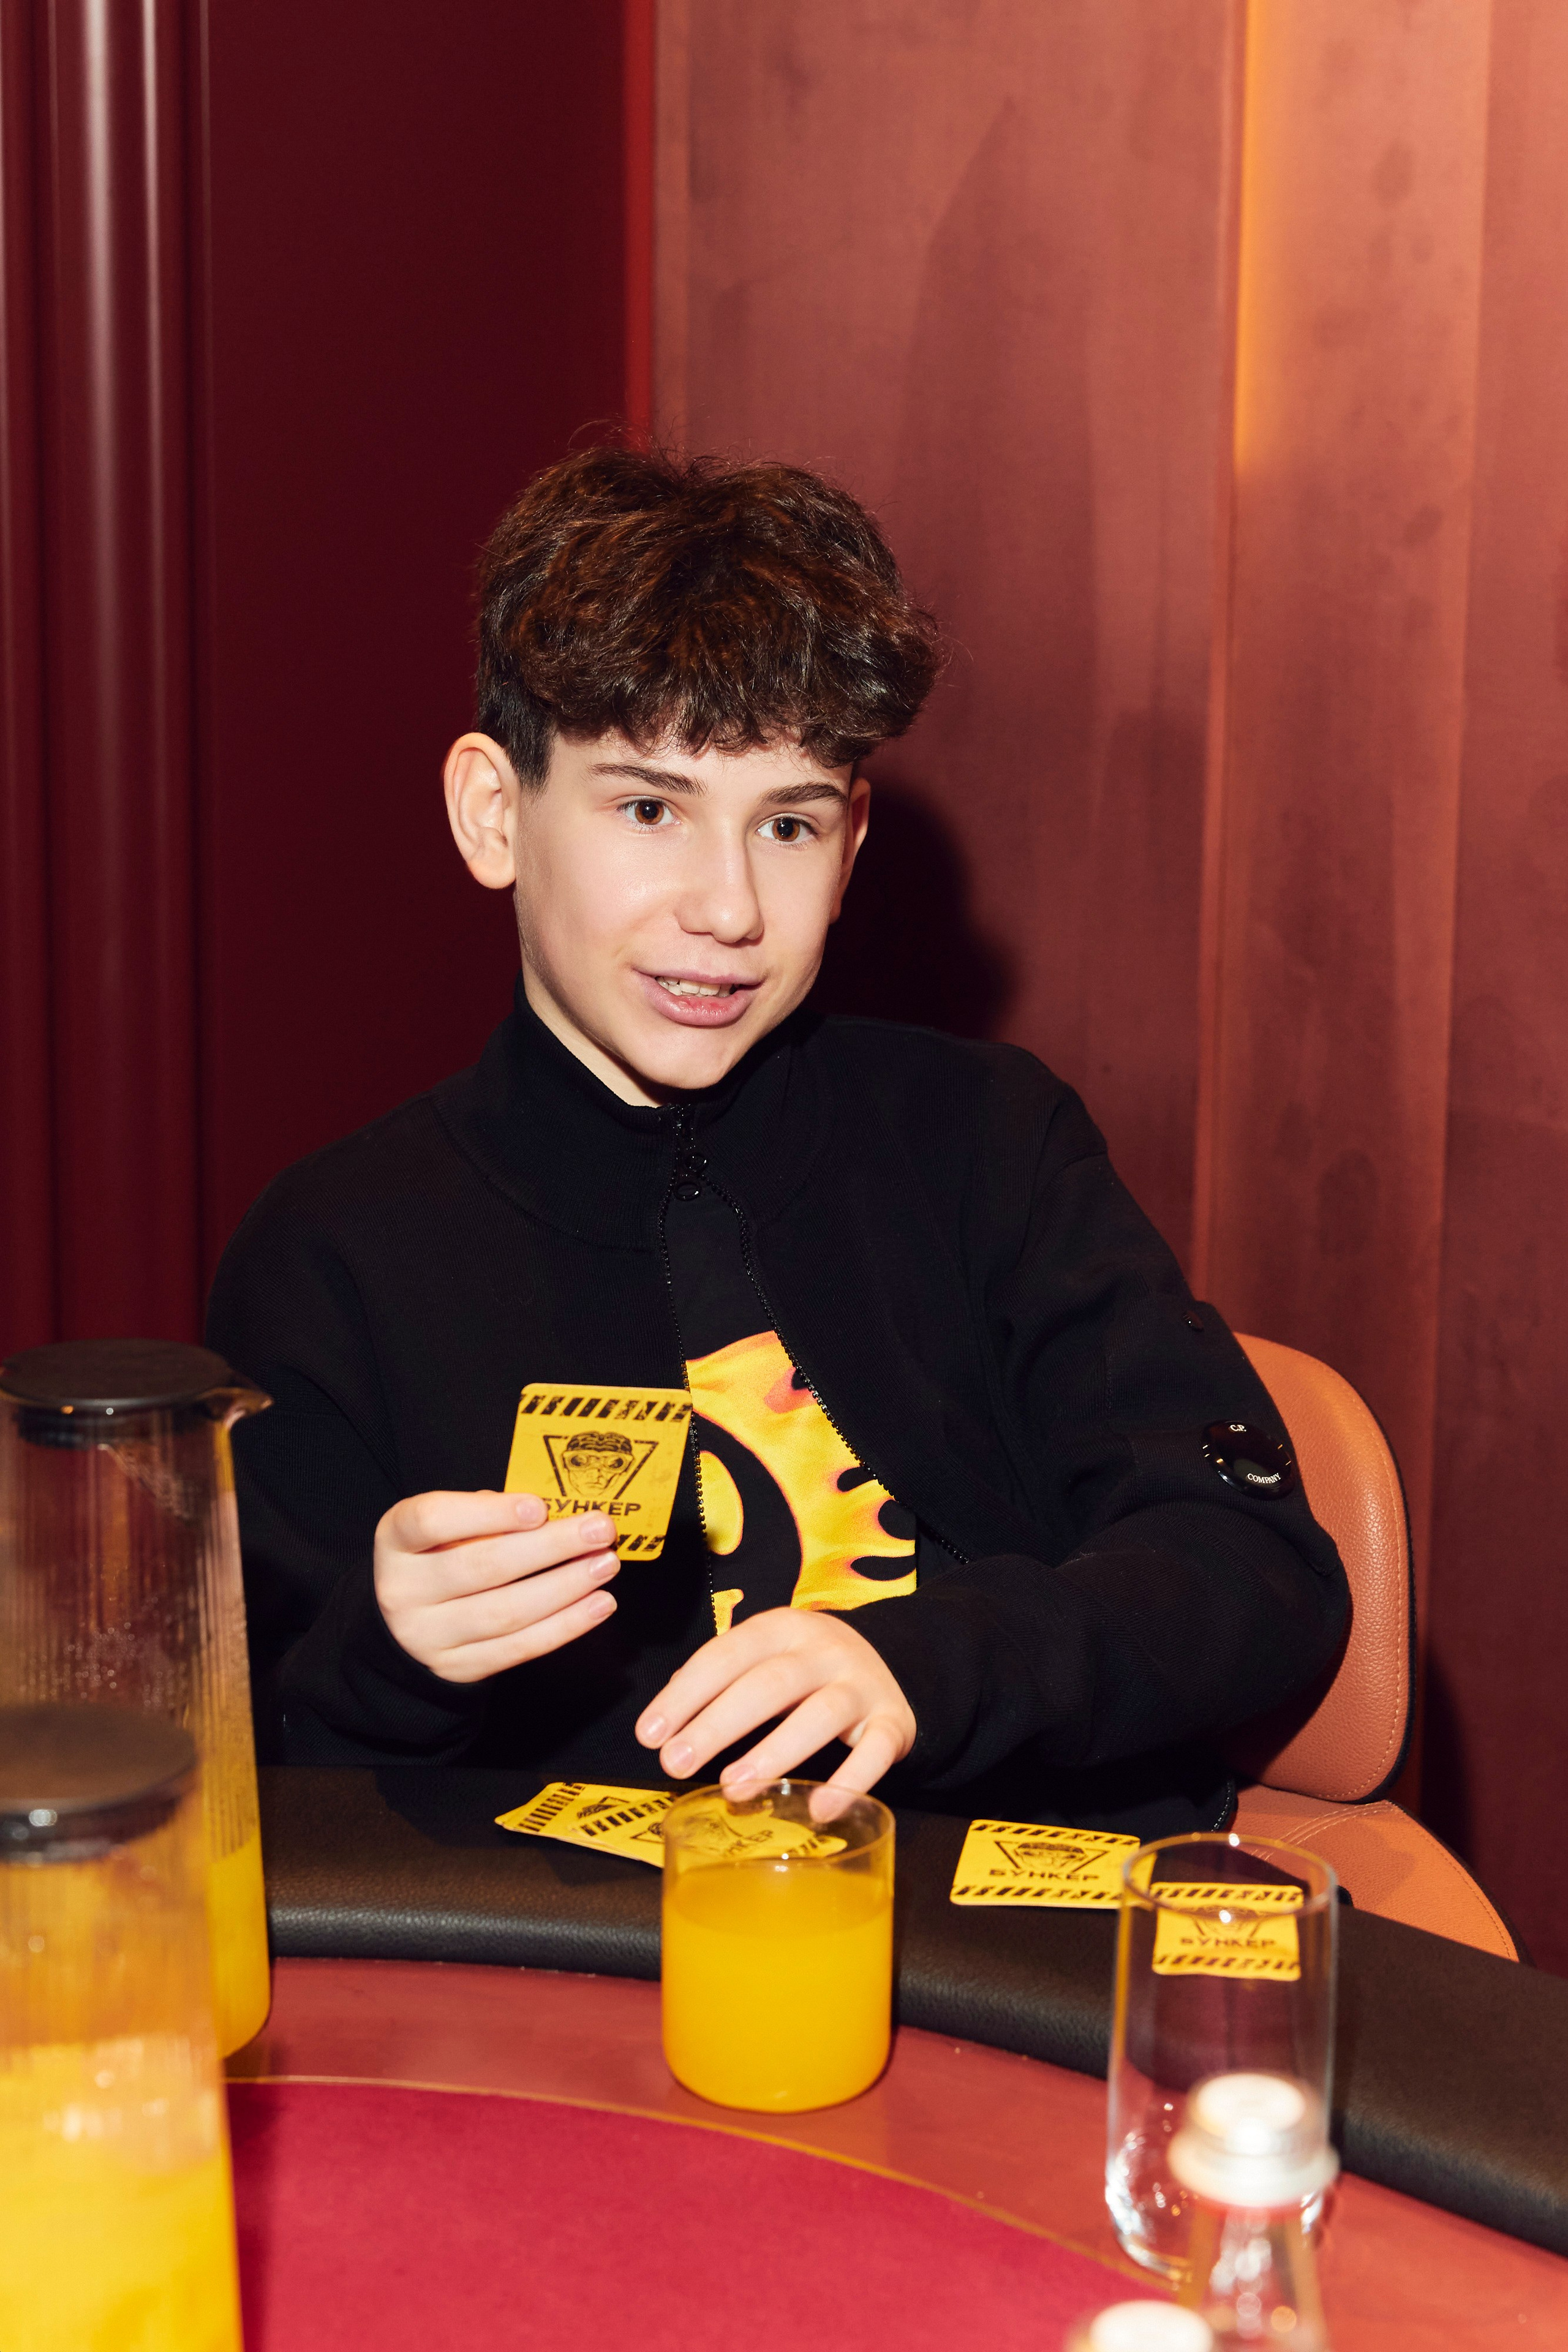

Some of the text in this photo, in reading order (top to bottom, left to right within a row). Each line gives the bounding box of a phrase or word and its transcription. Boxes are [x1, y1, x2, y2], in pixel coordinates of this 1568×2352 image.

[1247, 1472, 1281, 1484] COMPANY
[989, 1869, 1100, 1881] БУНКЕР
[1180, 1936, 1276, 1948] БУНКЕР
